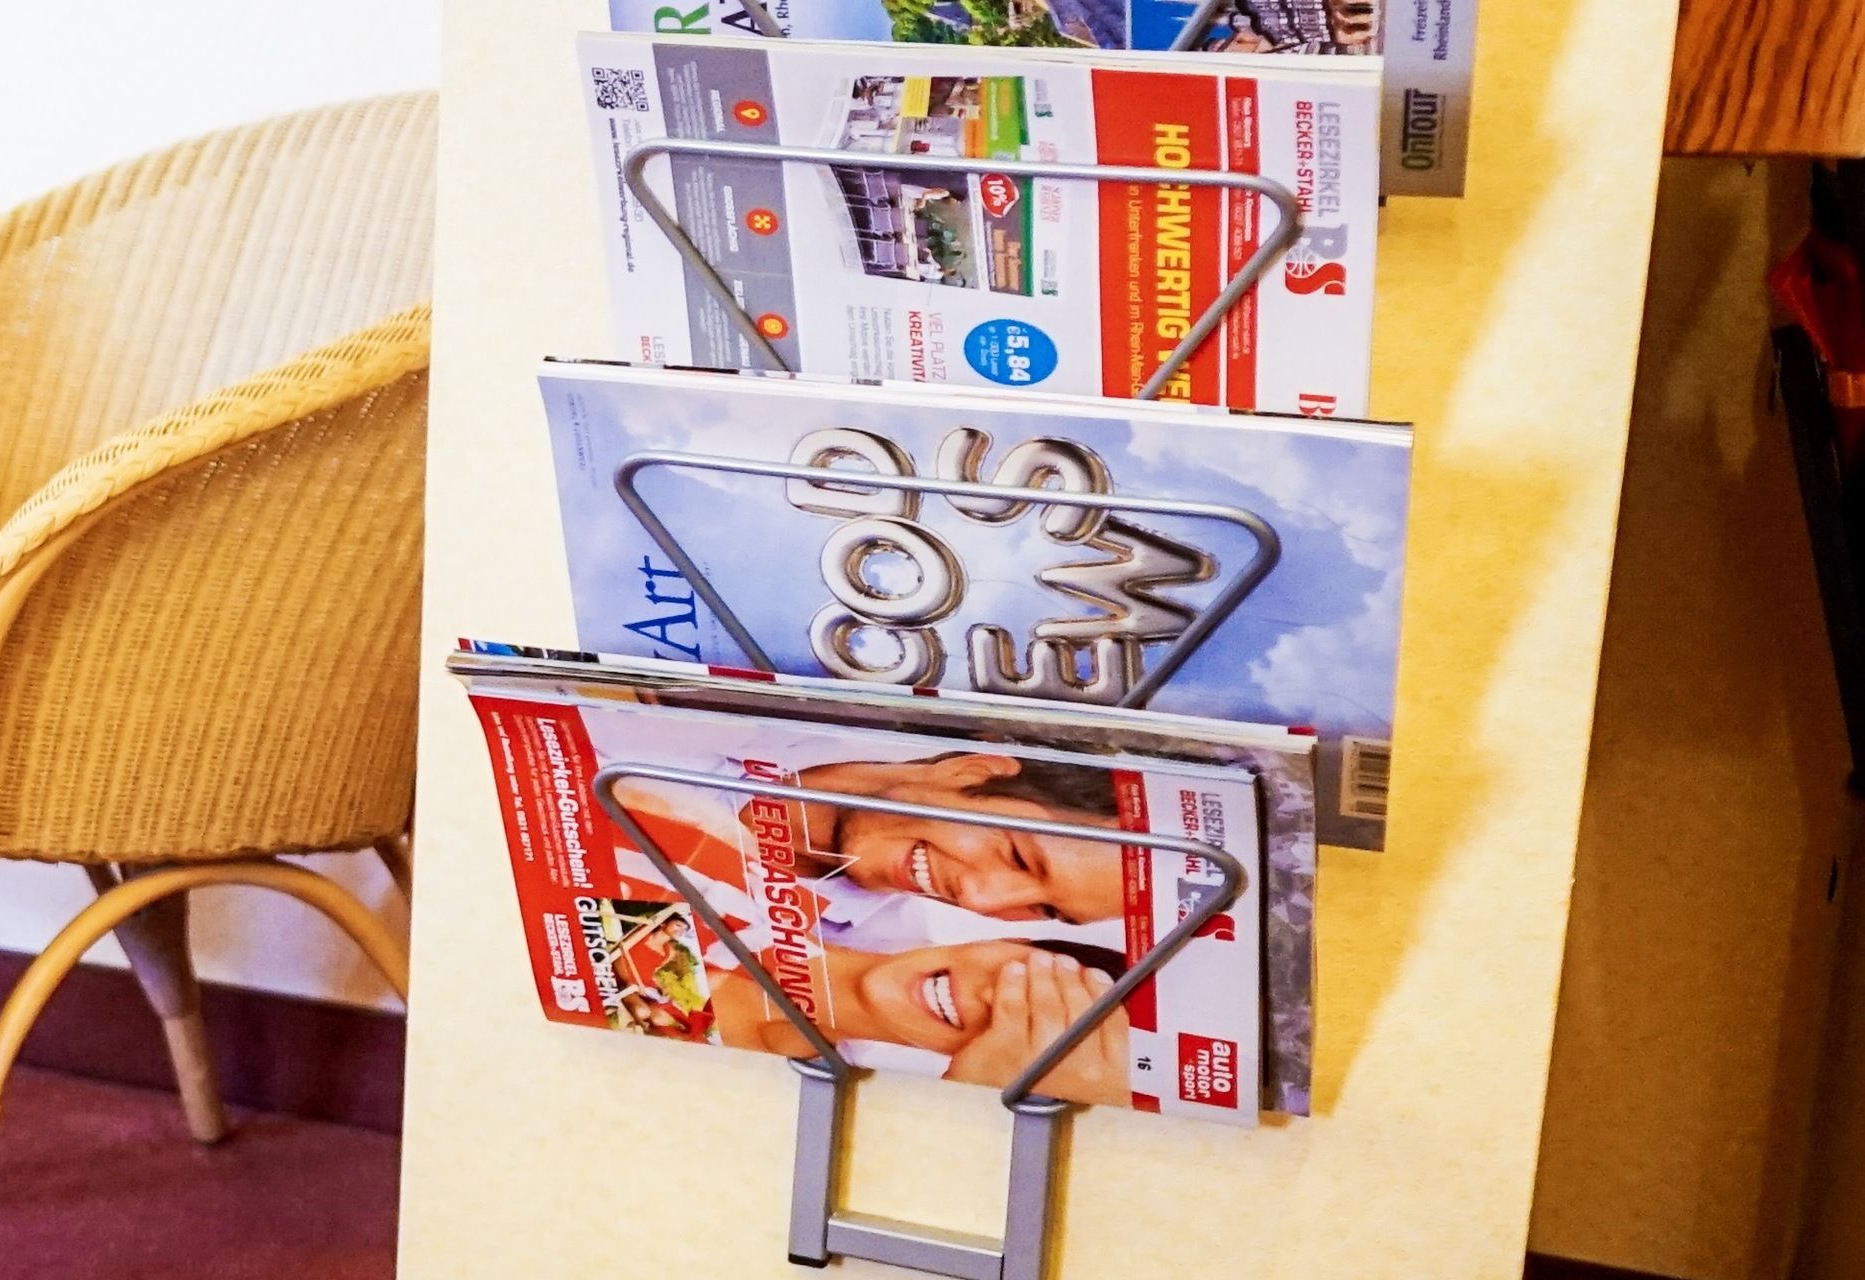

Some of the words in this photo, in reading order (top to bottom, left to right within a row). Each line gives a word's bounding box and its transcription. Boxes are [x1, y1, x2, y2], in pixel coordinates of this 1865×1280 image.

[1129, 185, 1142, 195] in
[1318, 102, 1341, 218] LESEZIRKEL
[988, 180, 1008, 207] 10%
[1128, 200, 1142, 277] Unterfranken
[1154, 123, 1191, 339] HOHWERTIG
[1129, 281, 1143, 301] und
[1129, 305, 1141, 320] im
[928, 312, 944, 336] VIEL
[930, 341, 946, 380] PLATZ
[784, 429, 968, 686] OOD
[935, 429, 1219, 697] EWS
[622, 555, 701, 662] Art
[537, 718, 594, 888] Lesezirkel-Gutschein!
[1180, 790, 1201, 875] BECKER+SAHL
[1201, 793, 1225, 877] LESEZIREL
[574, 896, 618, 1007] GUTSCHEIN
[550, 976, 590, 1013] BS
[1138, 1057, 1151, 1071] 16
[1197, 1049, 1212, 1098] motor
[1212, 1041, 1233, 1092] auto
